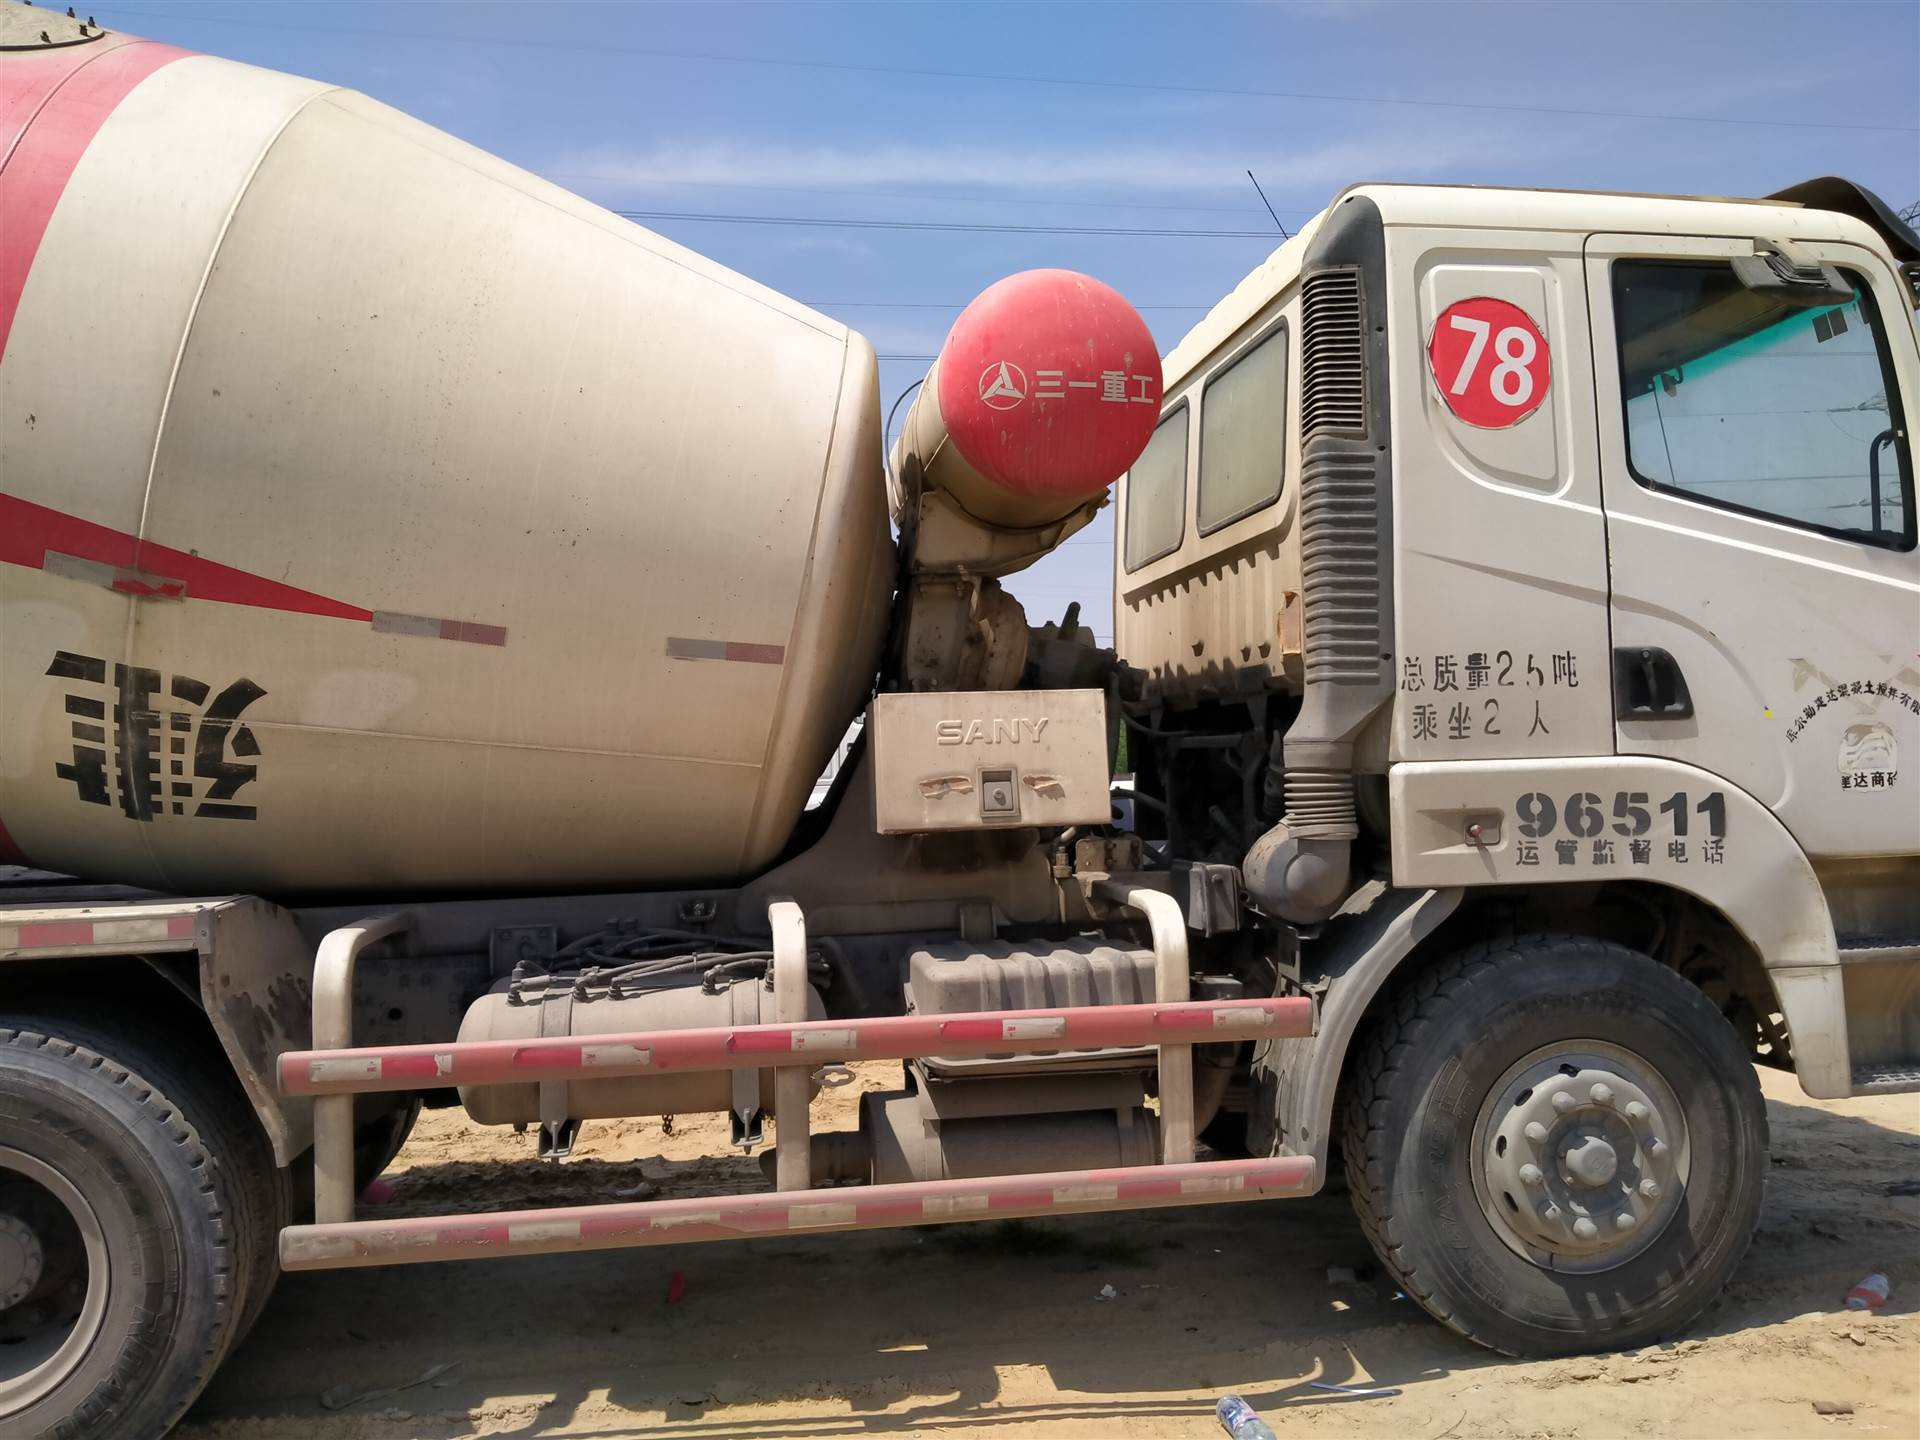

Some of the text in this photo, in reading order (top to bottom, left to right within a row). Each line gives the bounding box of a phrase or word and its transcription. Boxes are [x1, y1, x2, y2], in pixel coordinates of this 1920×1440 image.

[1450, 314, 1537, 406] 78
[1034, 369, 1155, 404] 三一重工
[935, 717, 1049, 746] SANY
[1515, 791, 1727, 838] 96511
[1515, 838, 1726, 866] 运管监督电话
